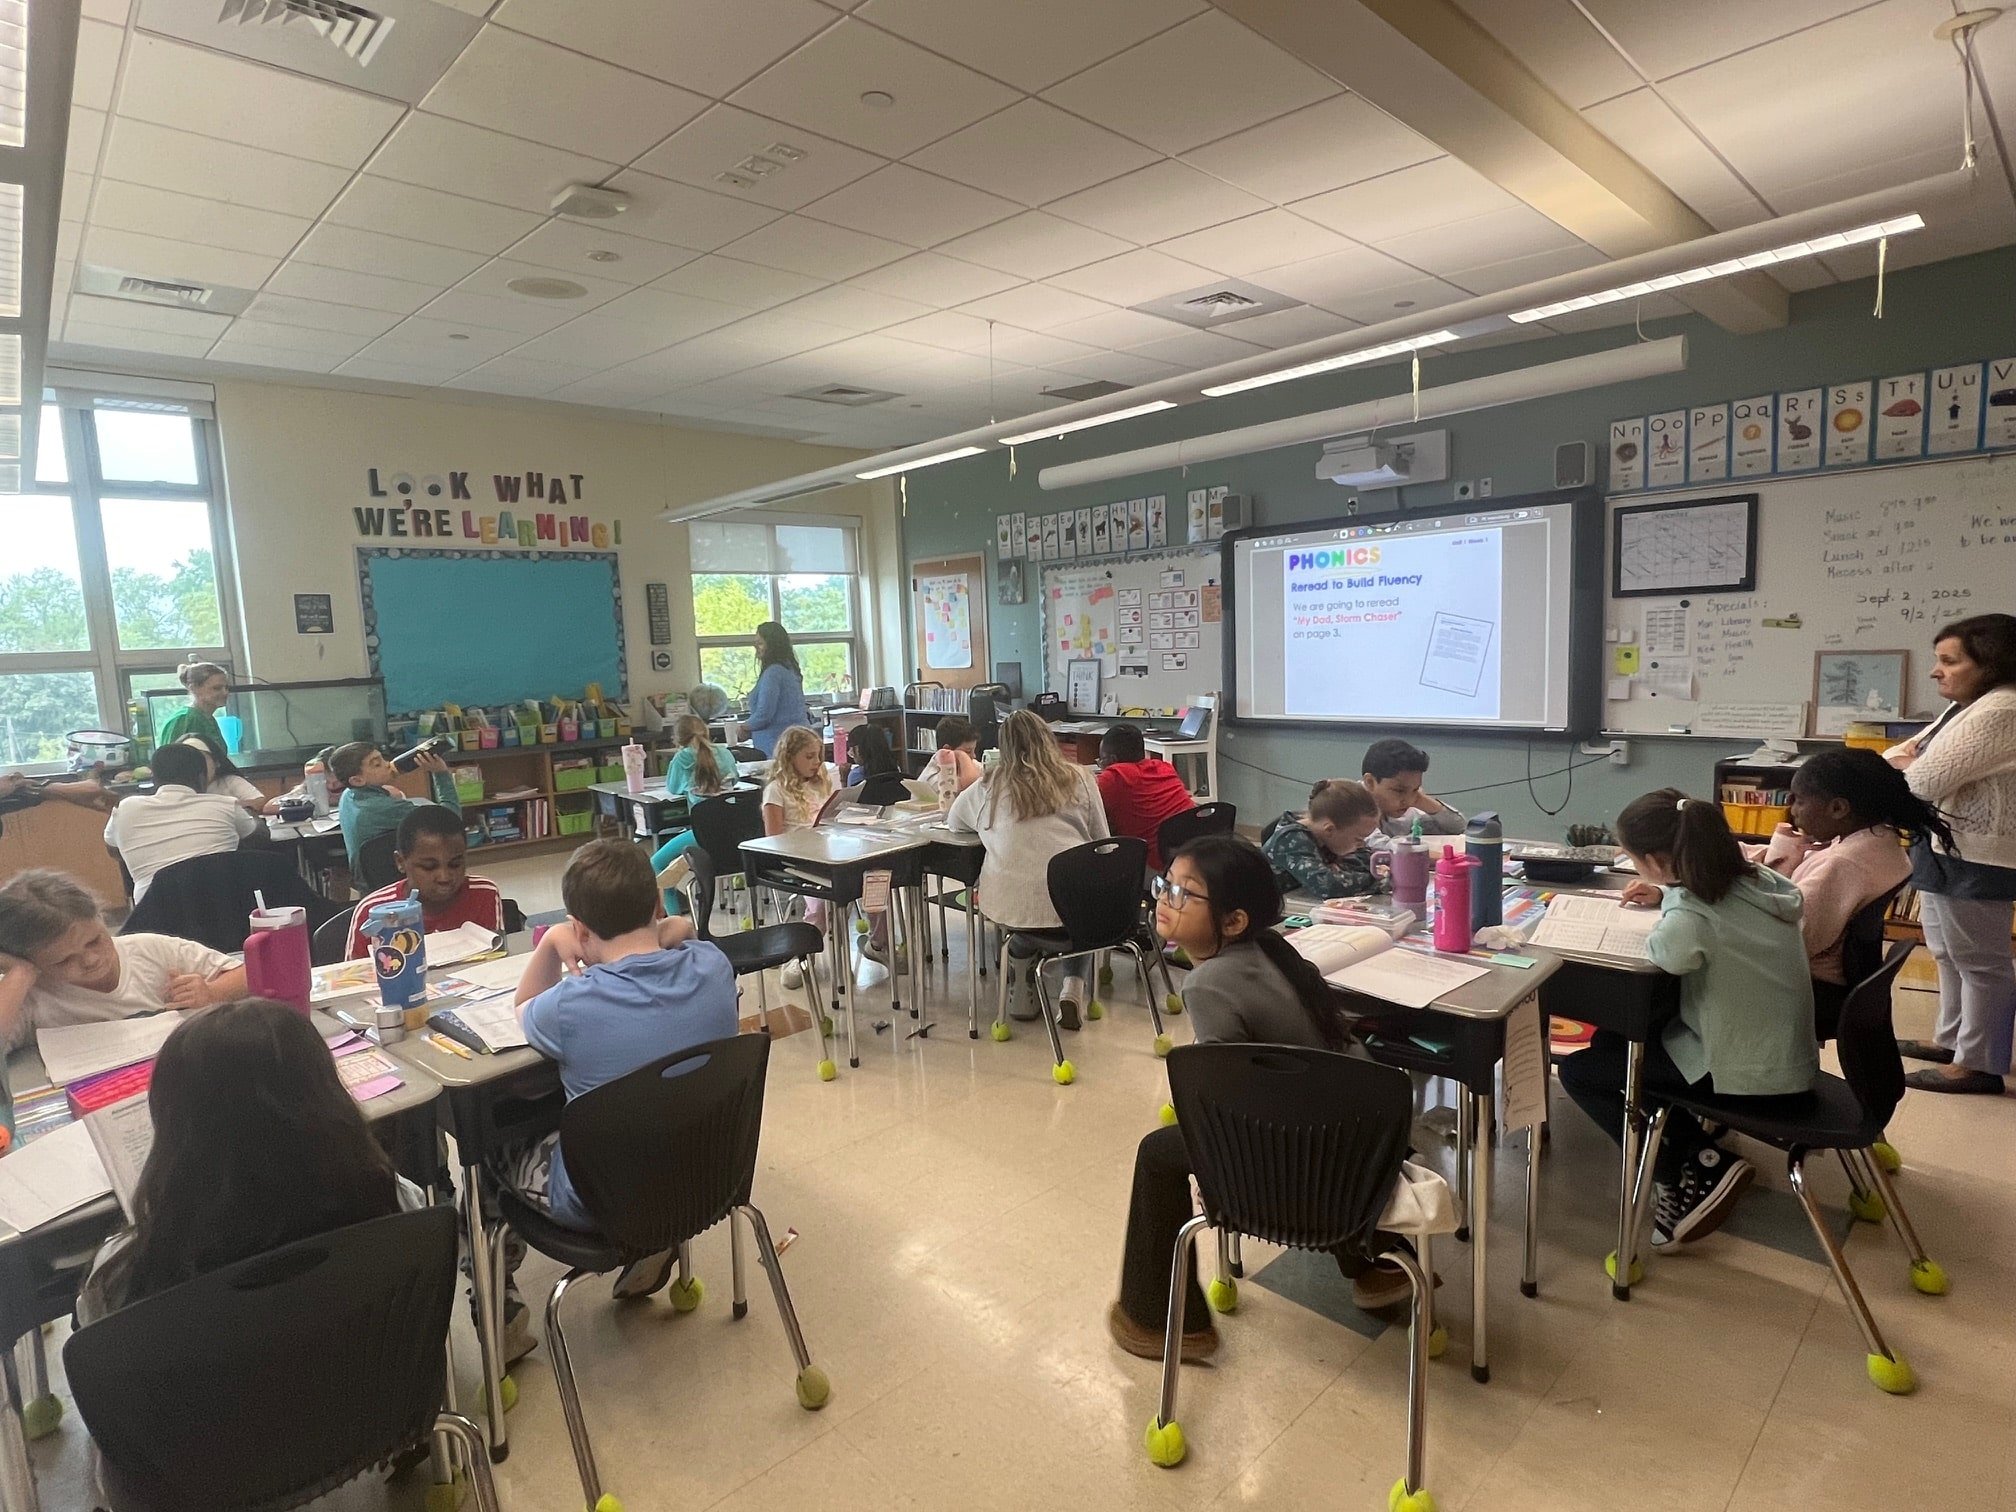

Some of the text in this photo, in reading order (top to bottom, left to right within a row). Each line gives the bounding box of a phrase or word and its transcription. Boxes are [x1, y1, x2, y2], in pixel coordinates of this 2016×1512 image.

[494, 472, 584, 504] WHAT
[353, 499, 622, 548] WE'RE LEARNING!
[1825, 508, 1861, 524] Music
[1289, 546, 1381, 571] PHONICS
[1823, 549, 1864, 563] Lunch
[1827, 566, 1872, 579] Recess
[1883, 561, 1914, 573] after
[1291, 574, 1423, 592] Reread to Build Fluency
[1293, 597, 1400, 612] We are going to reread
[1856, 588, 1895, 608] Sept.
[1931, 589, 1971, 599] 2025
[1335, 613, 1361, 623] Storm
[1720, 616, 1752, 628] Library
[1293, 628, 1341, 639] on page 3.
[1724, 640, 1754, 651] Health
[1072, 671, 1093, 681] THINK
